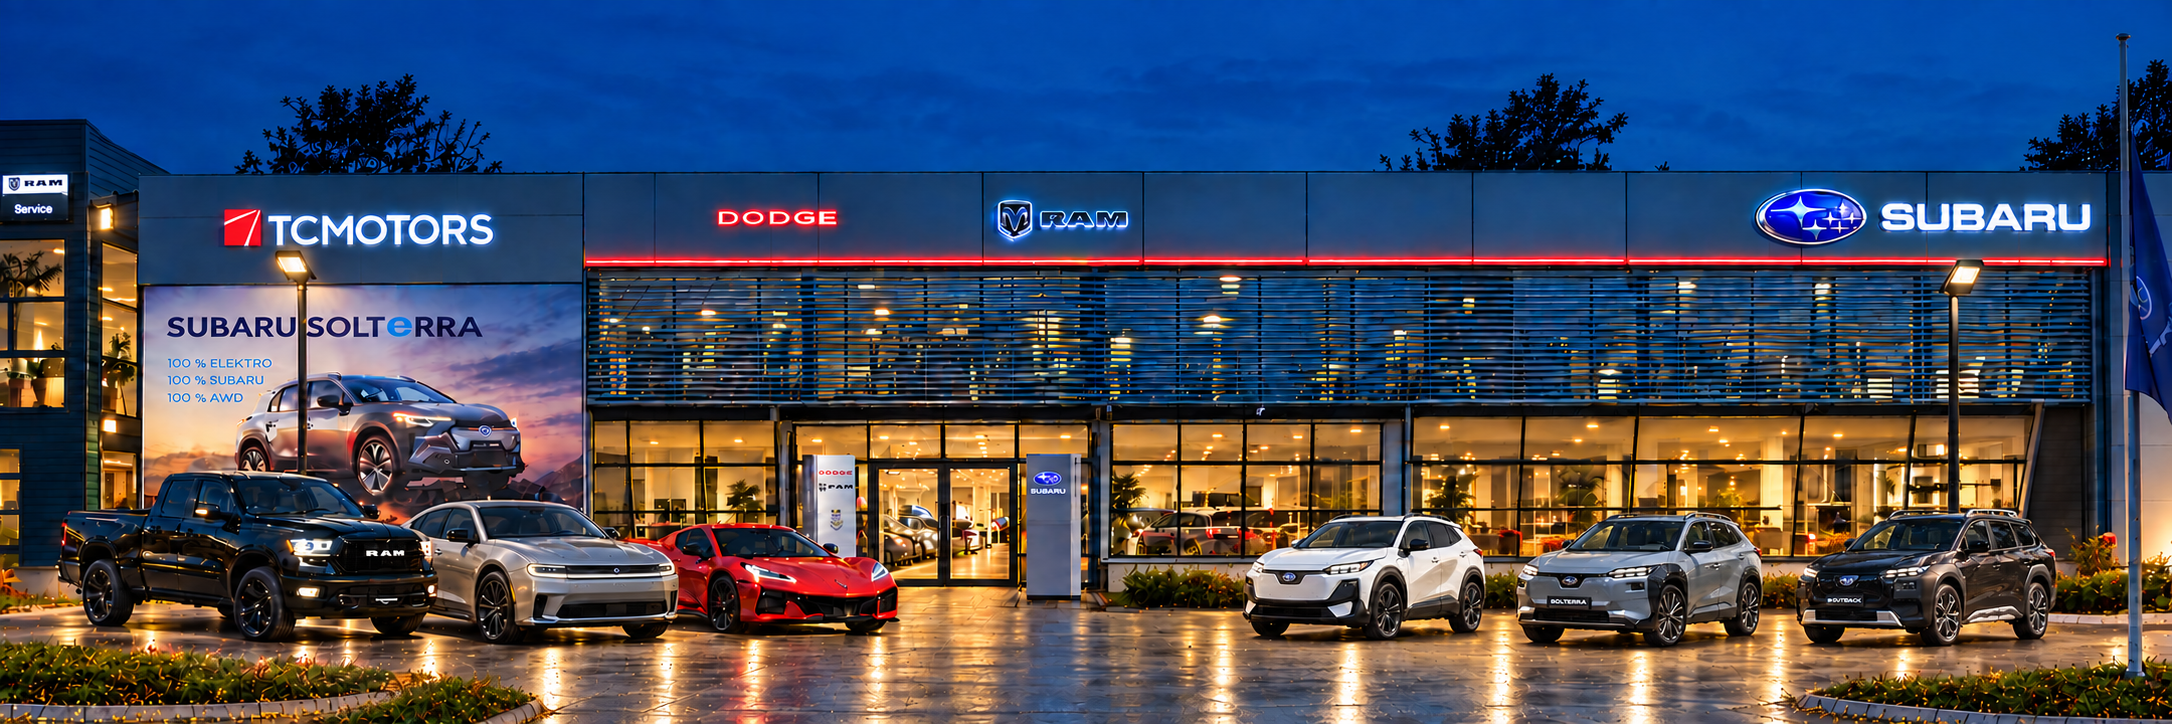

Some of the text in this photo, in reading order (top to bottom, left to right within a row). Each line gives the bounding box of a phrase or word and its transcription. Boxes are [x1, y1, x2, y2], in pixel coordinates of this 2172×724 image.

[24, 179, 63, 187] RAM
[14, 203, 53, 214] Service
[717, 209, 838, 226] DODGE
[1040, 210, 1129, 228] RAM
[1880, 202, 2092, 231] SUBARU
[267, 213, 495, 246] TCMOTORS
[166, 316, 297, 338] SUBARU
[167, 358, 273, 369] 100 % ELEKTRO
[167, 375, 264, 386] 100 % SUBARU
[167, 392, 244, 403] 100 % AWD
[365, 549, 405, 557] RAM
